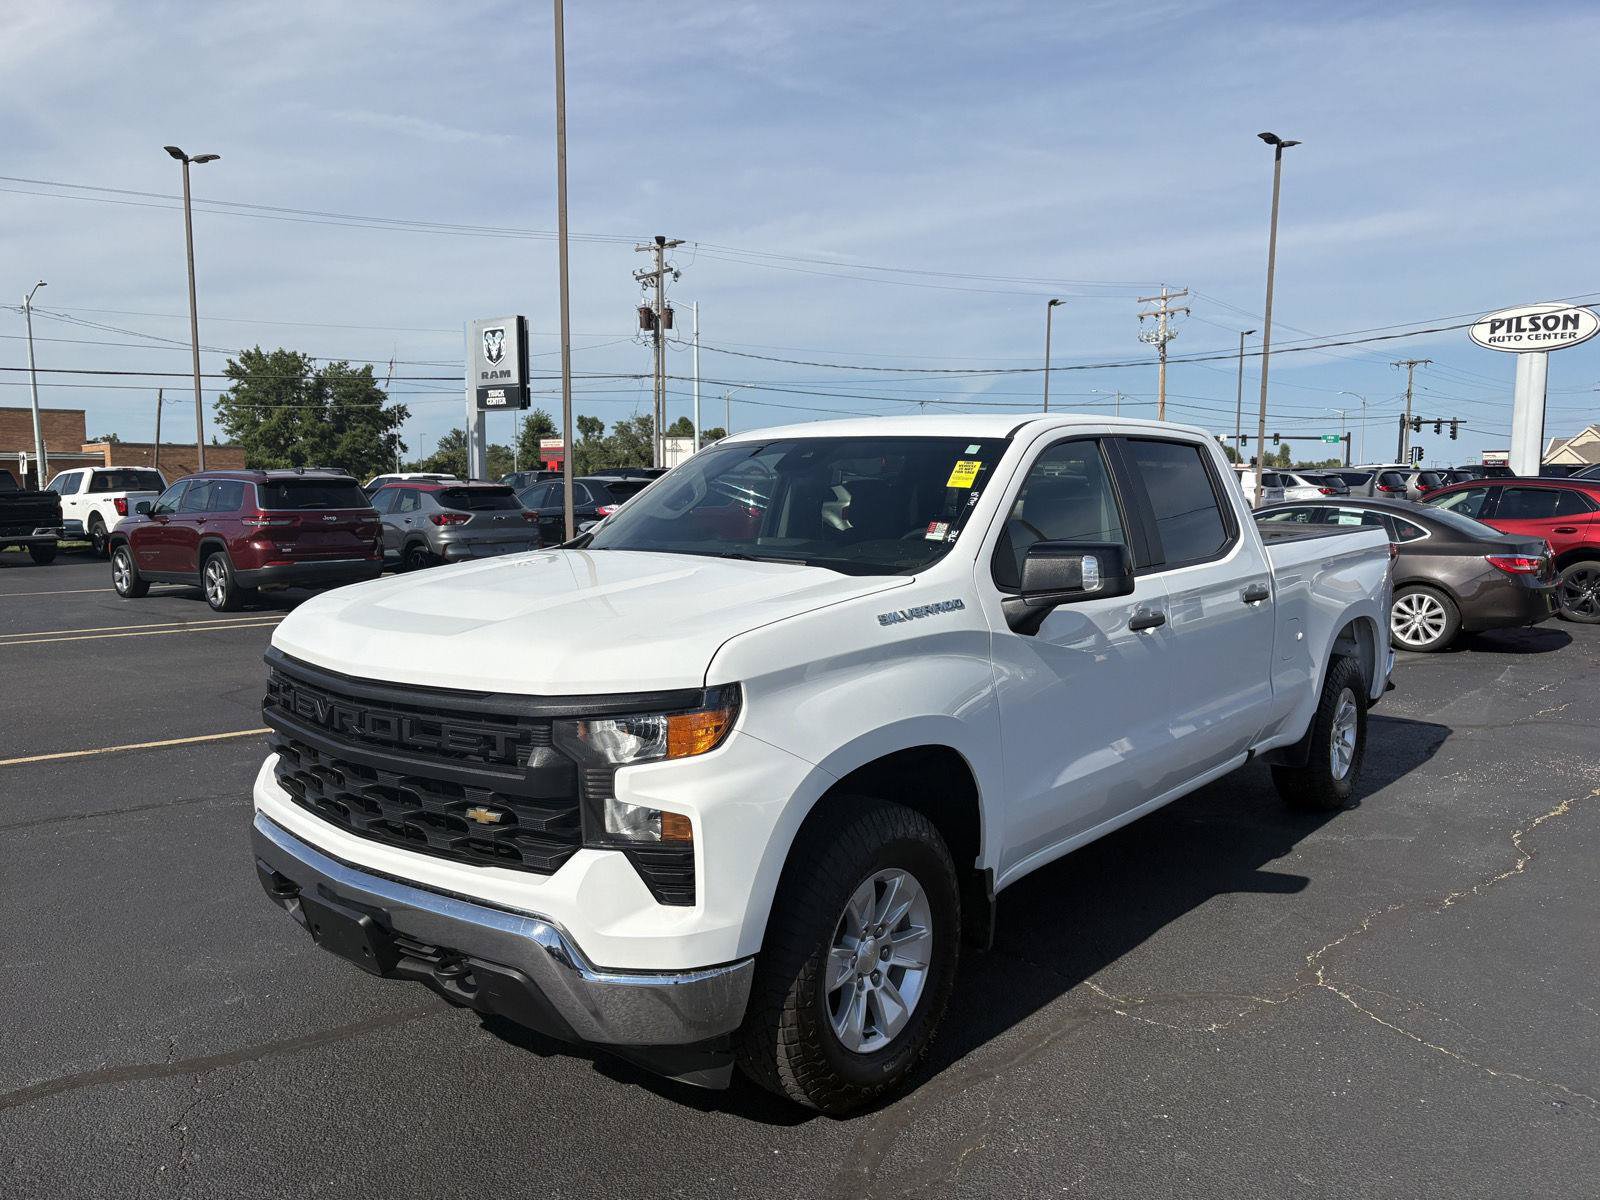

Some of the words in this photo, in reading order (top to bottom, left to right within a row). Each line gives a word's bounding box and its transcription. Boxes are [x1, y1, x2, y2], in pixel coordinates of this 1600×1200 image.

[1489, 313, 1580, 334] PILSON
[1488, 335, 1523, 343] AUTO
[1527, 332, 1578, 341] CENTER
[481, 370, 511, 380] RAM
[488, 390, 505, 398] TRUCK
[486, 397, 507, 405] CENTER
[877, 599, 966, 627] SILVERADO
